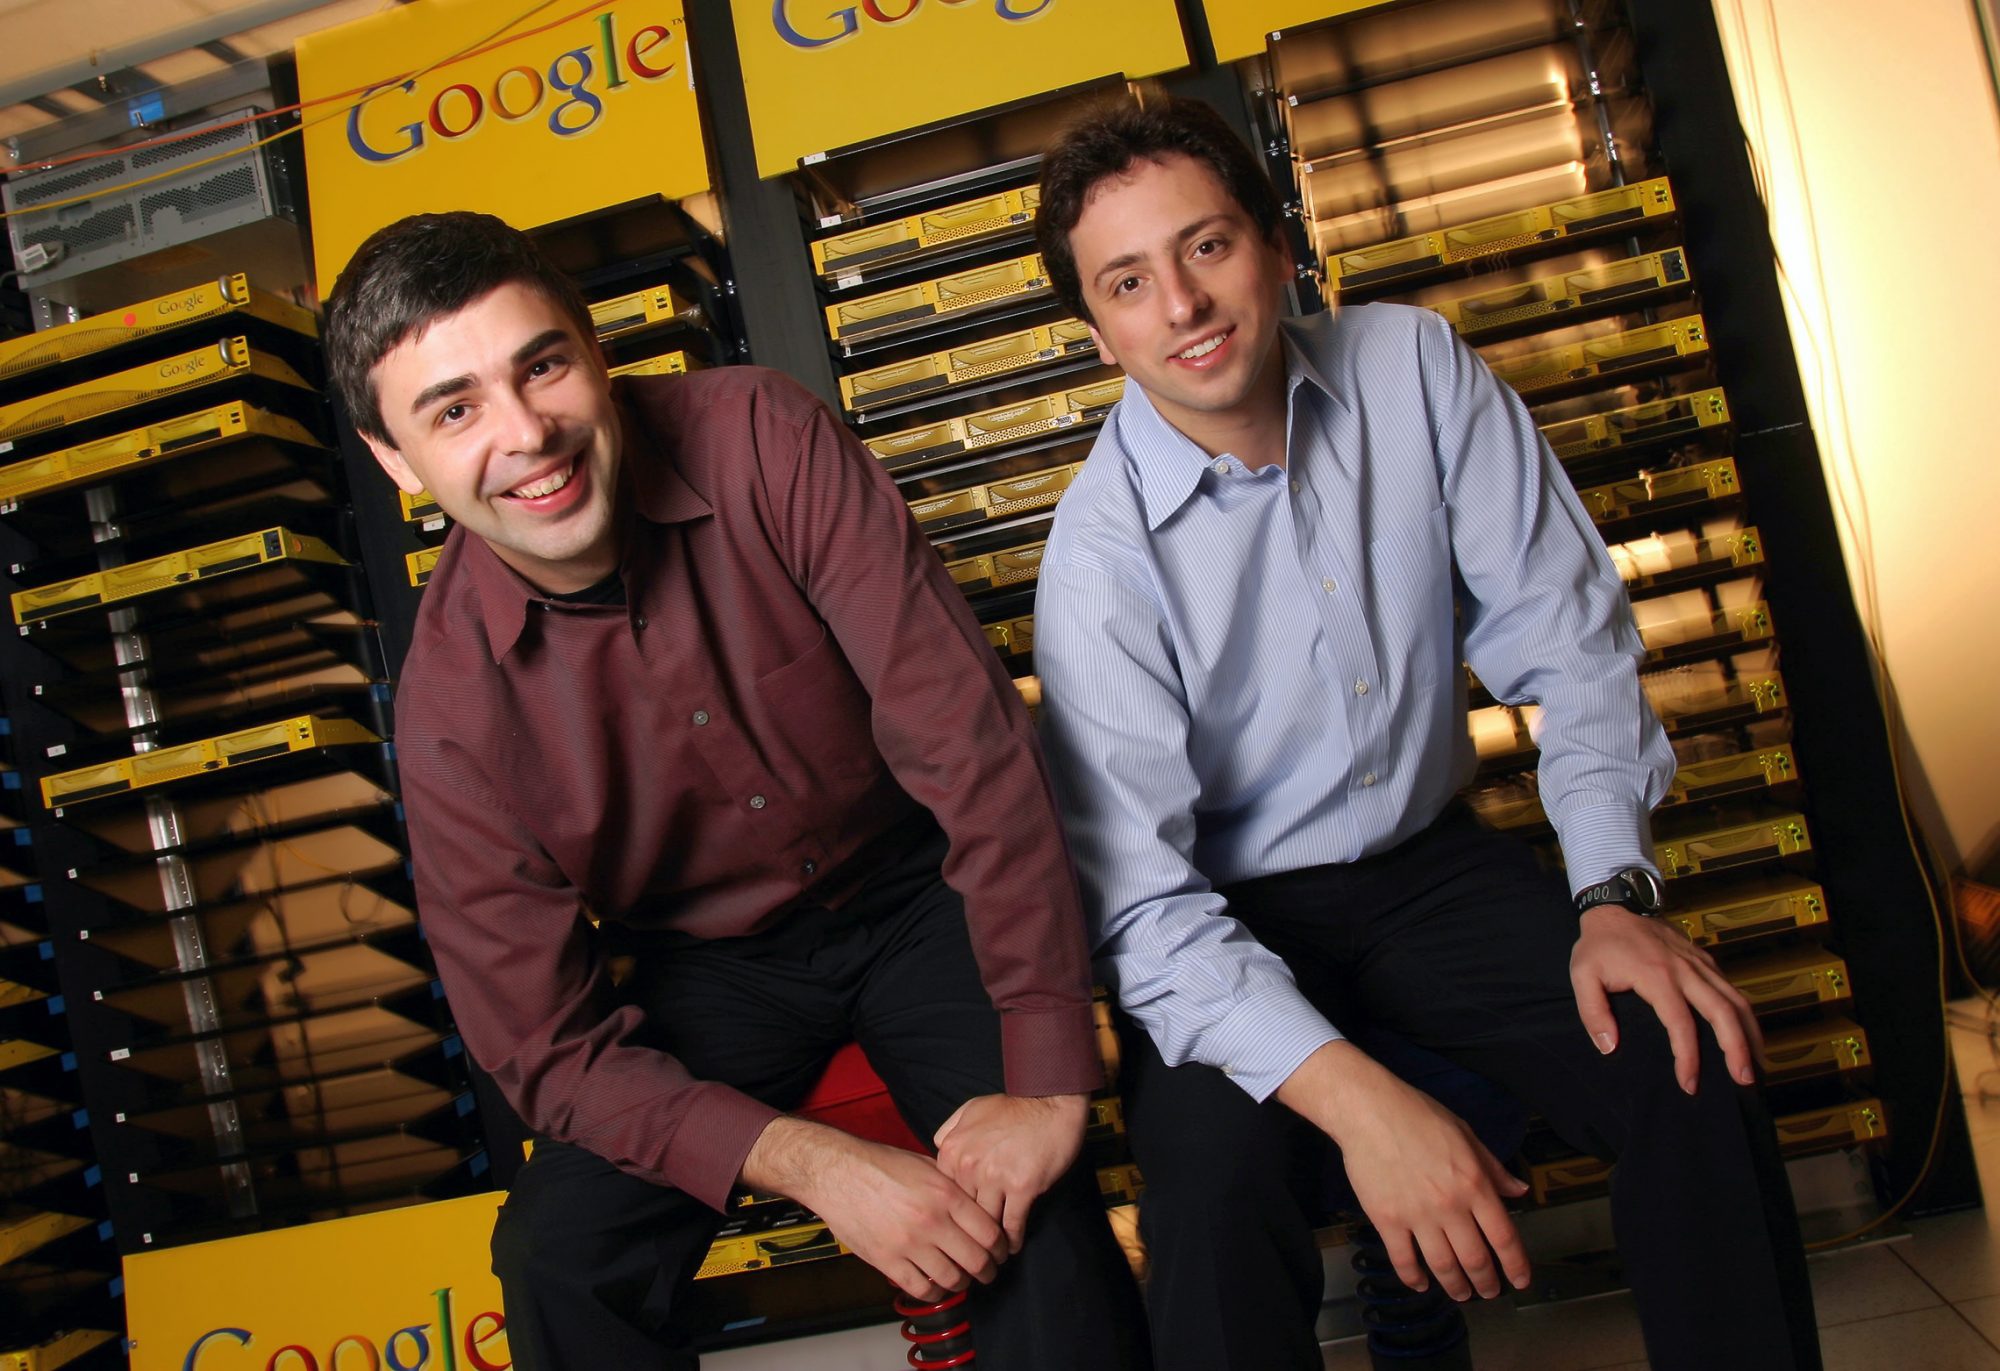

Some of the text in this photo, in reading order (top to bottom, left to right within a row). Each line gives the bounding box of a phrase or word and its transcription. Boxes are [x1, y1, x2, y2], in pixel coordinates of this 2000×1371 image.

[346, 12, 675, 162] Google
[158, 293, 203, 315] Google
[160, 356, 205, 378] Google
